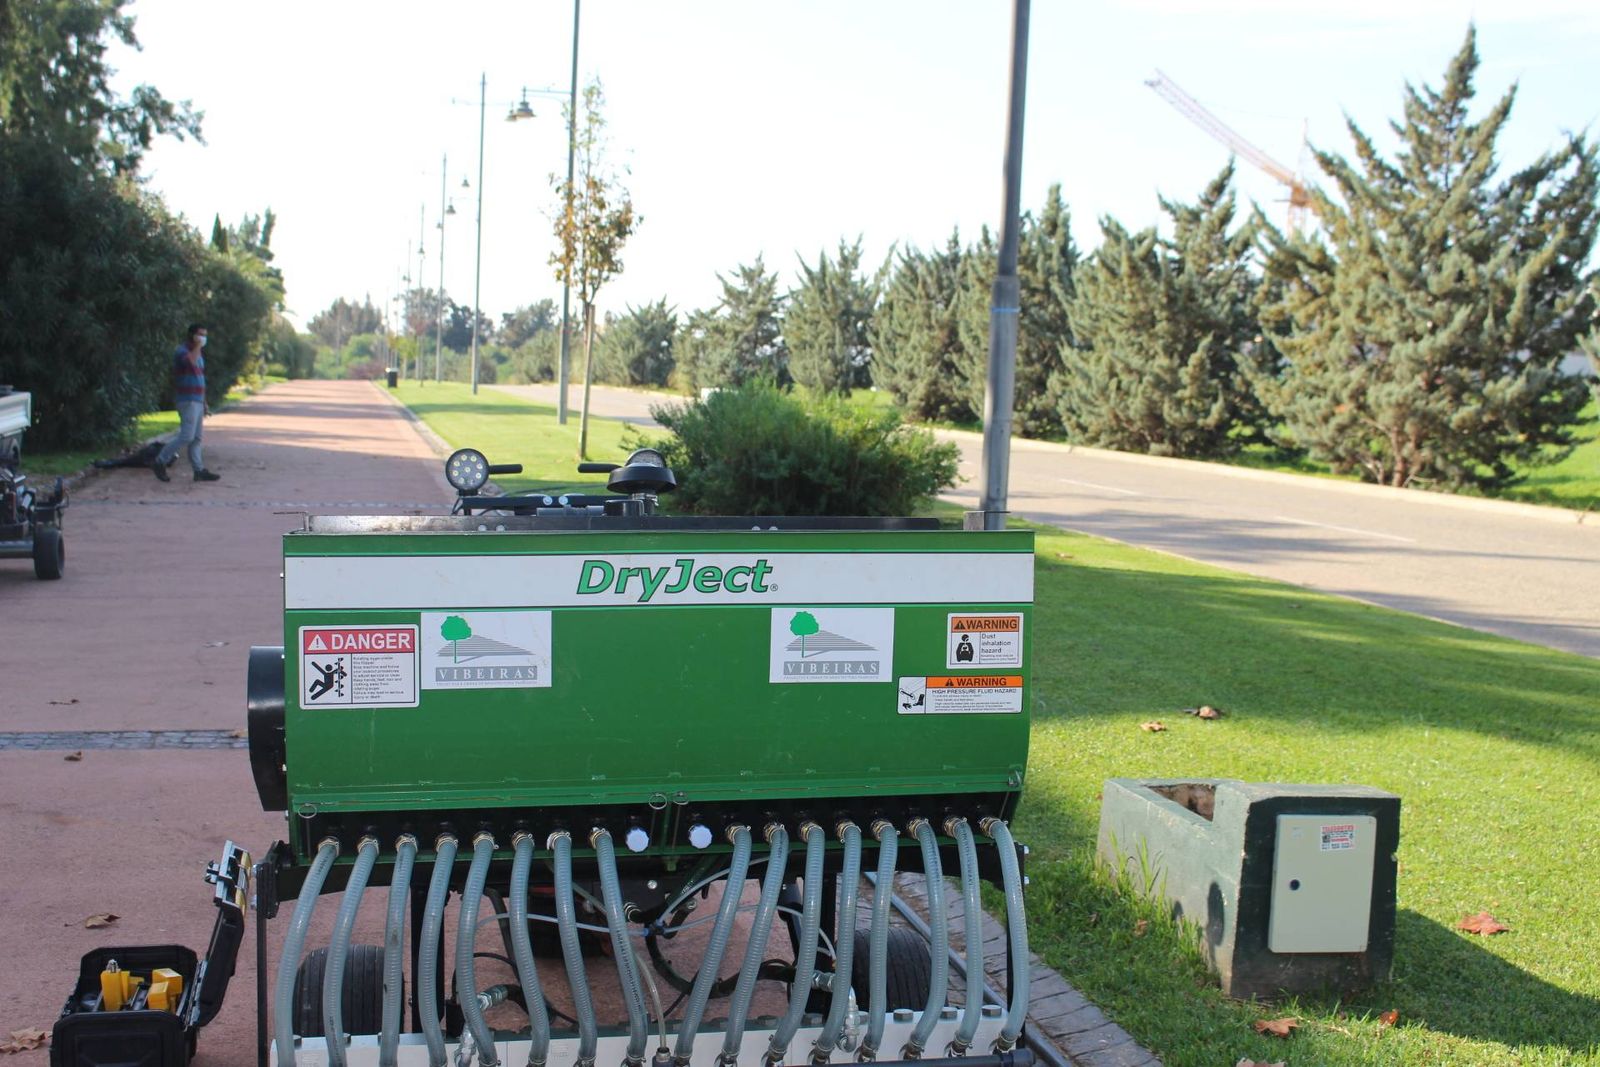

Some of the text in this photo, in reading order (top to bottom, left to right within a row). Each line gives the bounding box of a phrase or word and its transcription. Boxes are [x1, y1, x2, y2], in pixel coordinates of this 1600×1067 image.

[966, 619, 1017, 629] WARNING
[331, 633, 411, 650] DANGER
[438, 667, 535, 680] VIBEIRAS
[787, 663, 877, 674] VIBEIRAS
[957, 678, 1007, 686] WARNING
